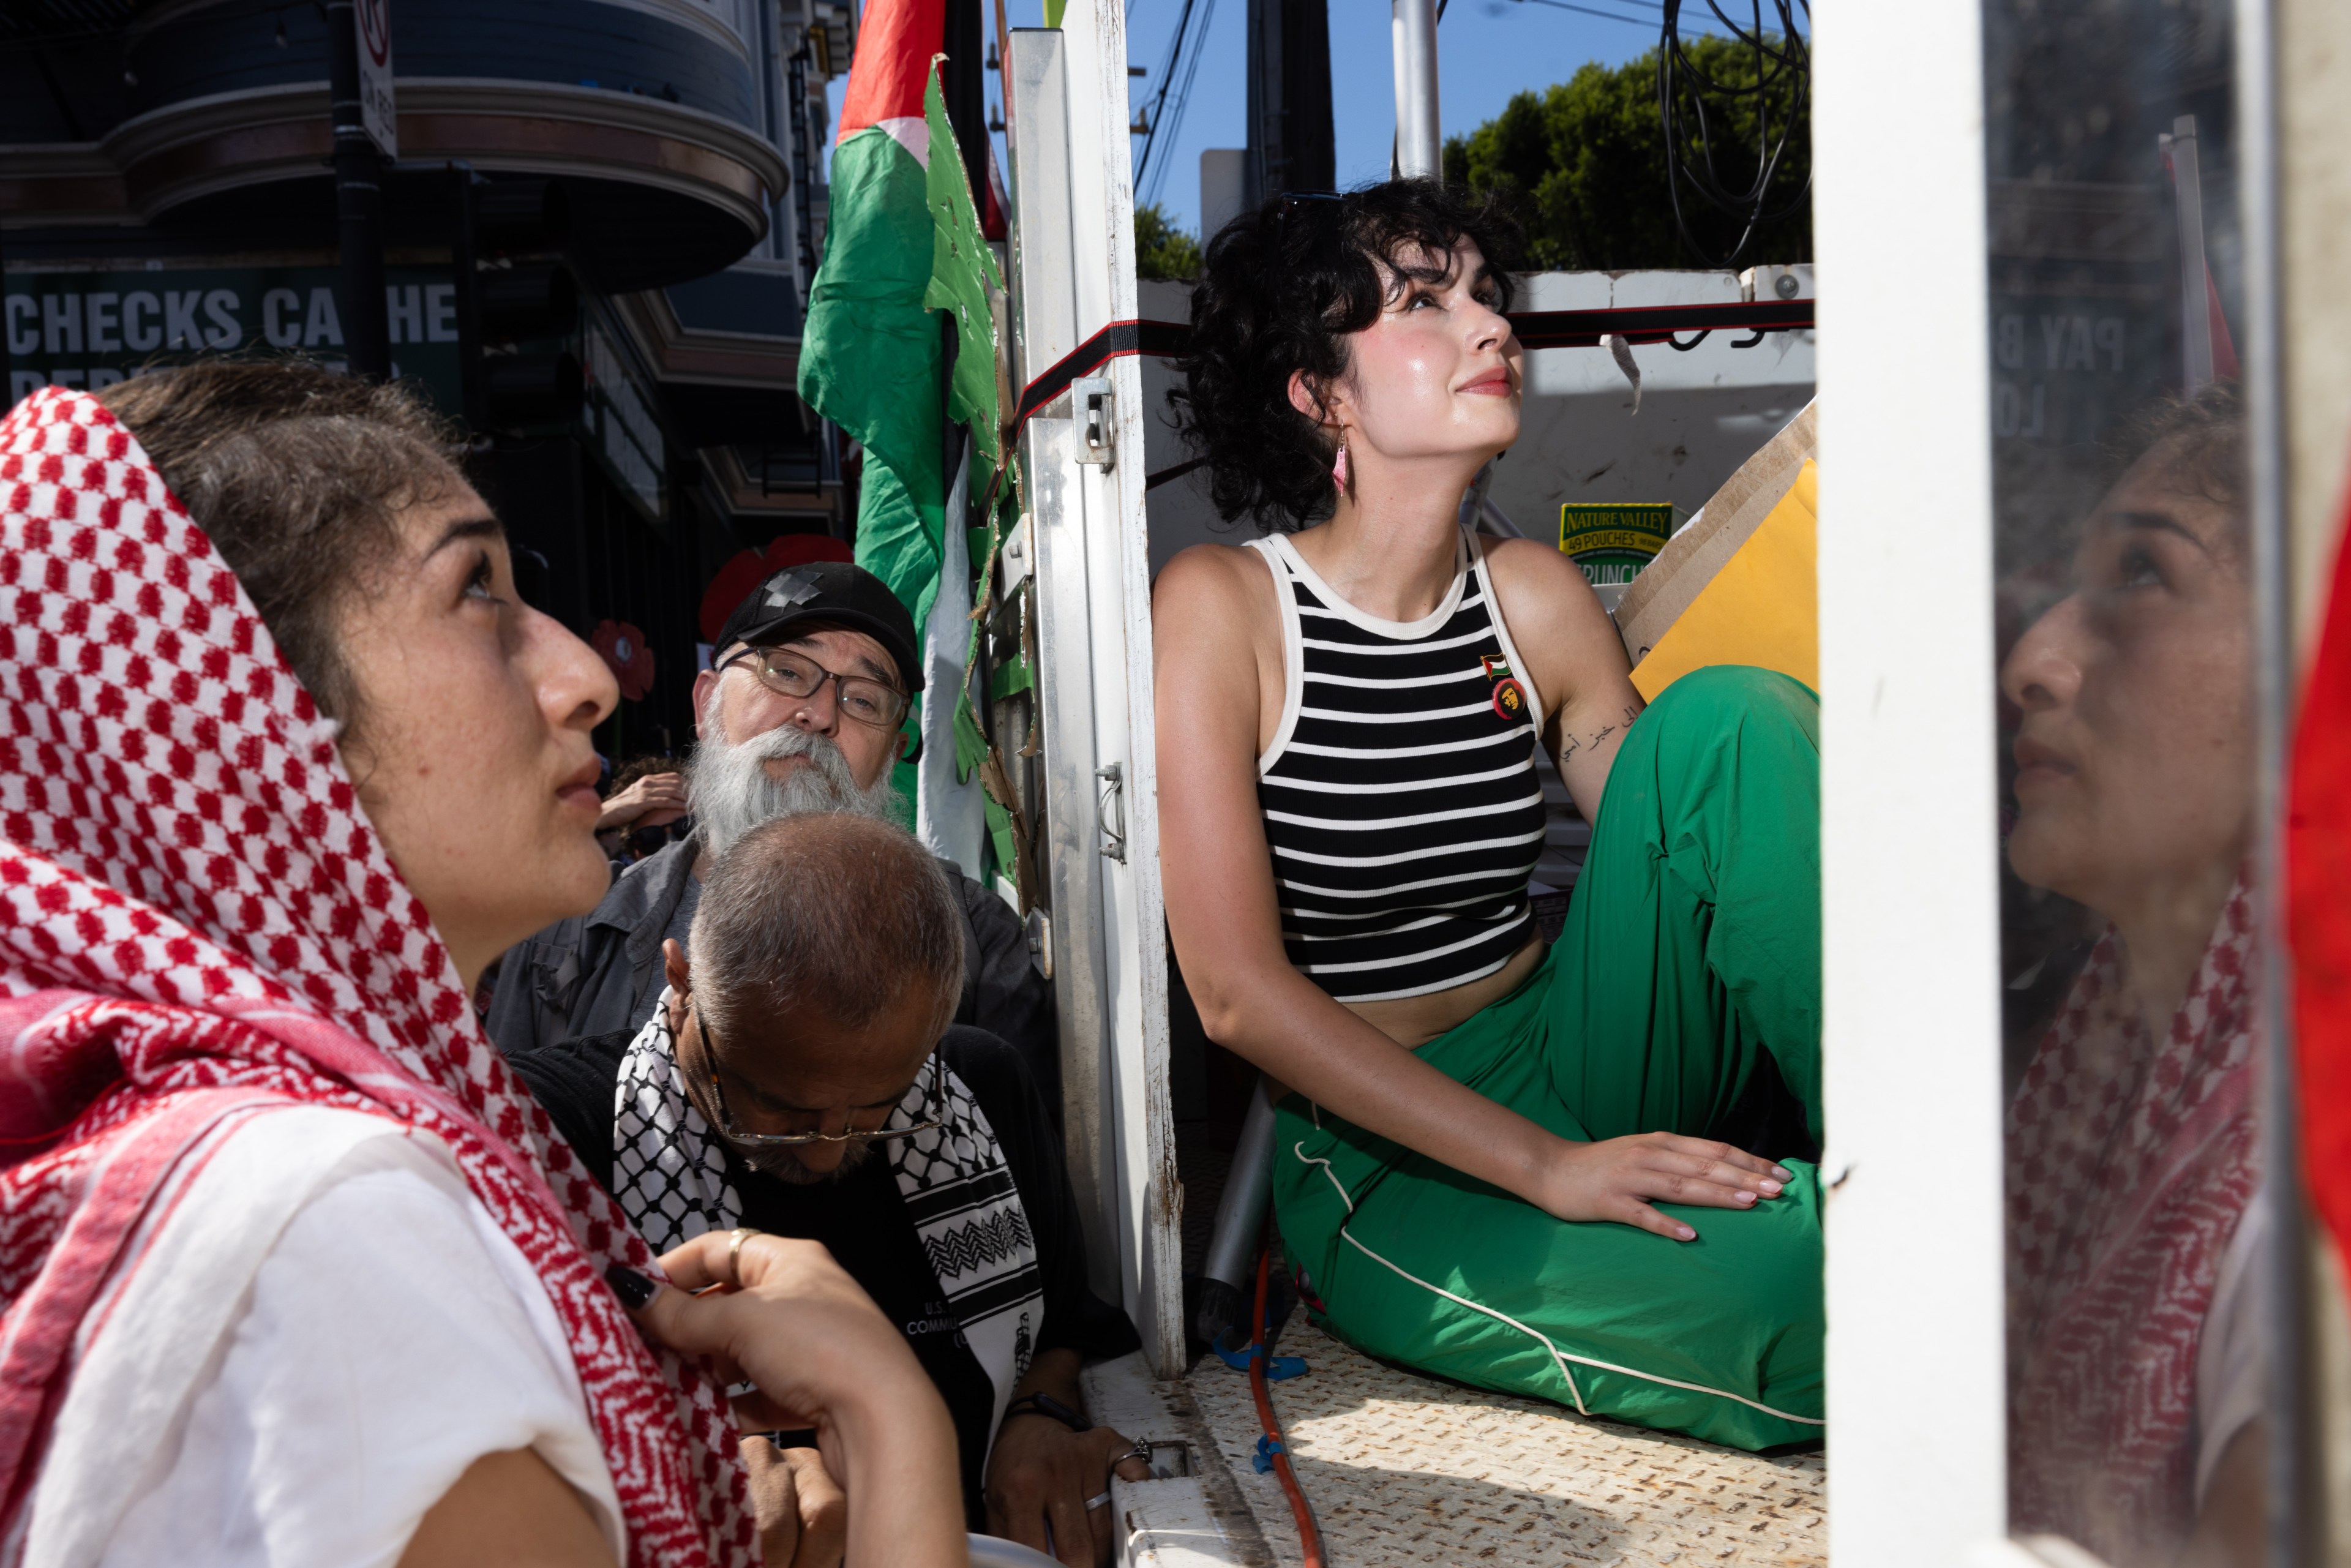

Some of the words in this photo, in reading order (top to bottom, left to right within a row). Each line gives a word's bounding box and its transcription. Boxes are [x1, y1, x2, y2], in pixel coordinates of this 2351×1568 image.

[6, 289, 243, 355] CHECKS
[262, 283, 459, 348] CAHE
[1565, 512, 1618, 533] NATURE
[1619, 512, 1668, 533] VALLEY
[1569, 538, 1582, 550] 49
[1584, 531, 1635, 547] POUCHES
[1588, 726, 1616, 752] خبز
[924, 1301, 947, 1315] U.S.
